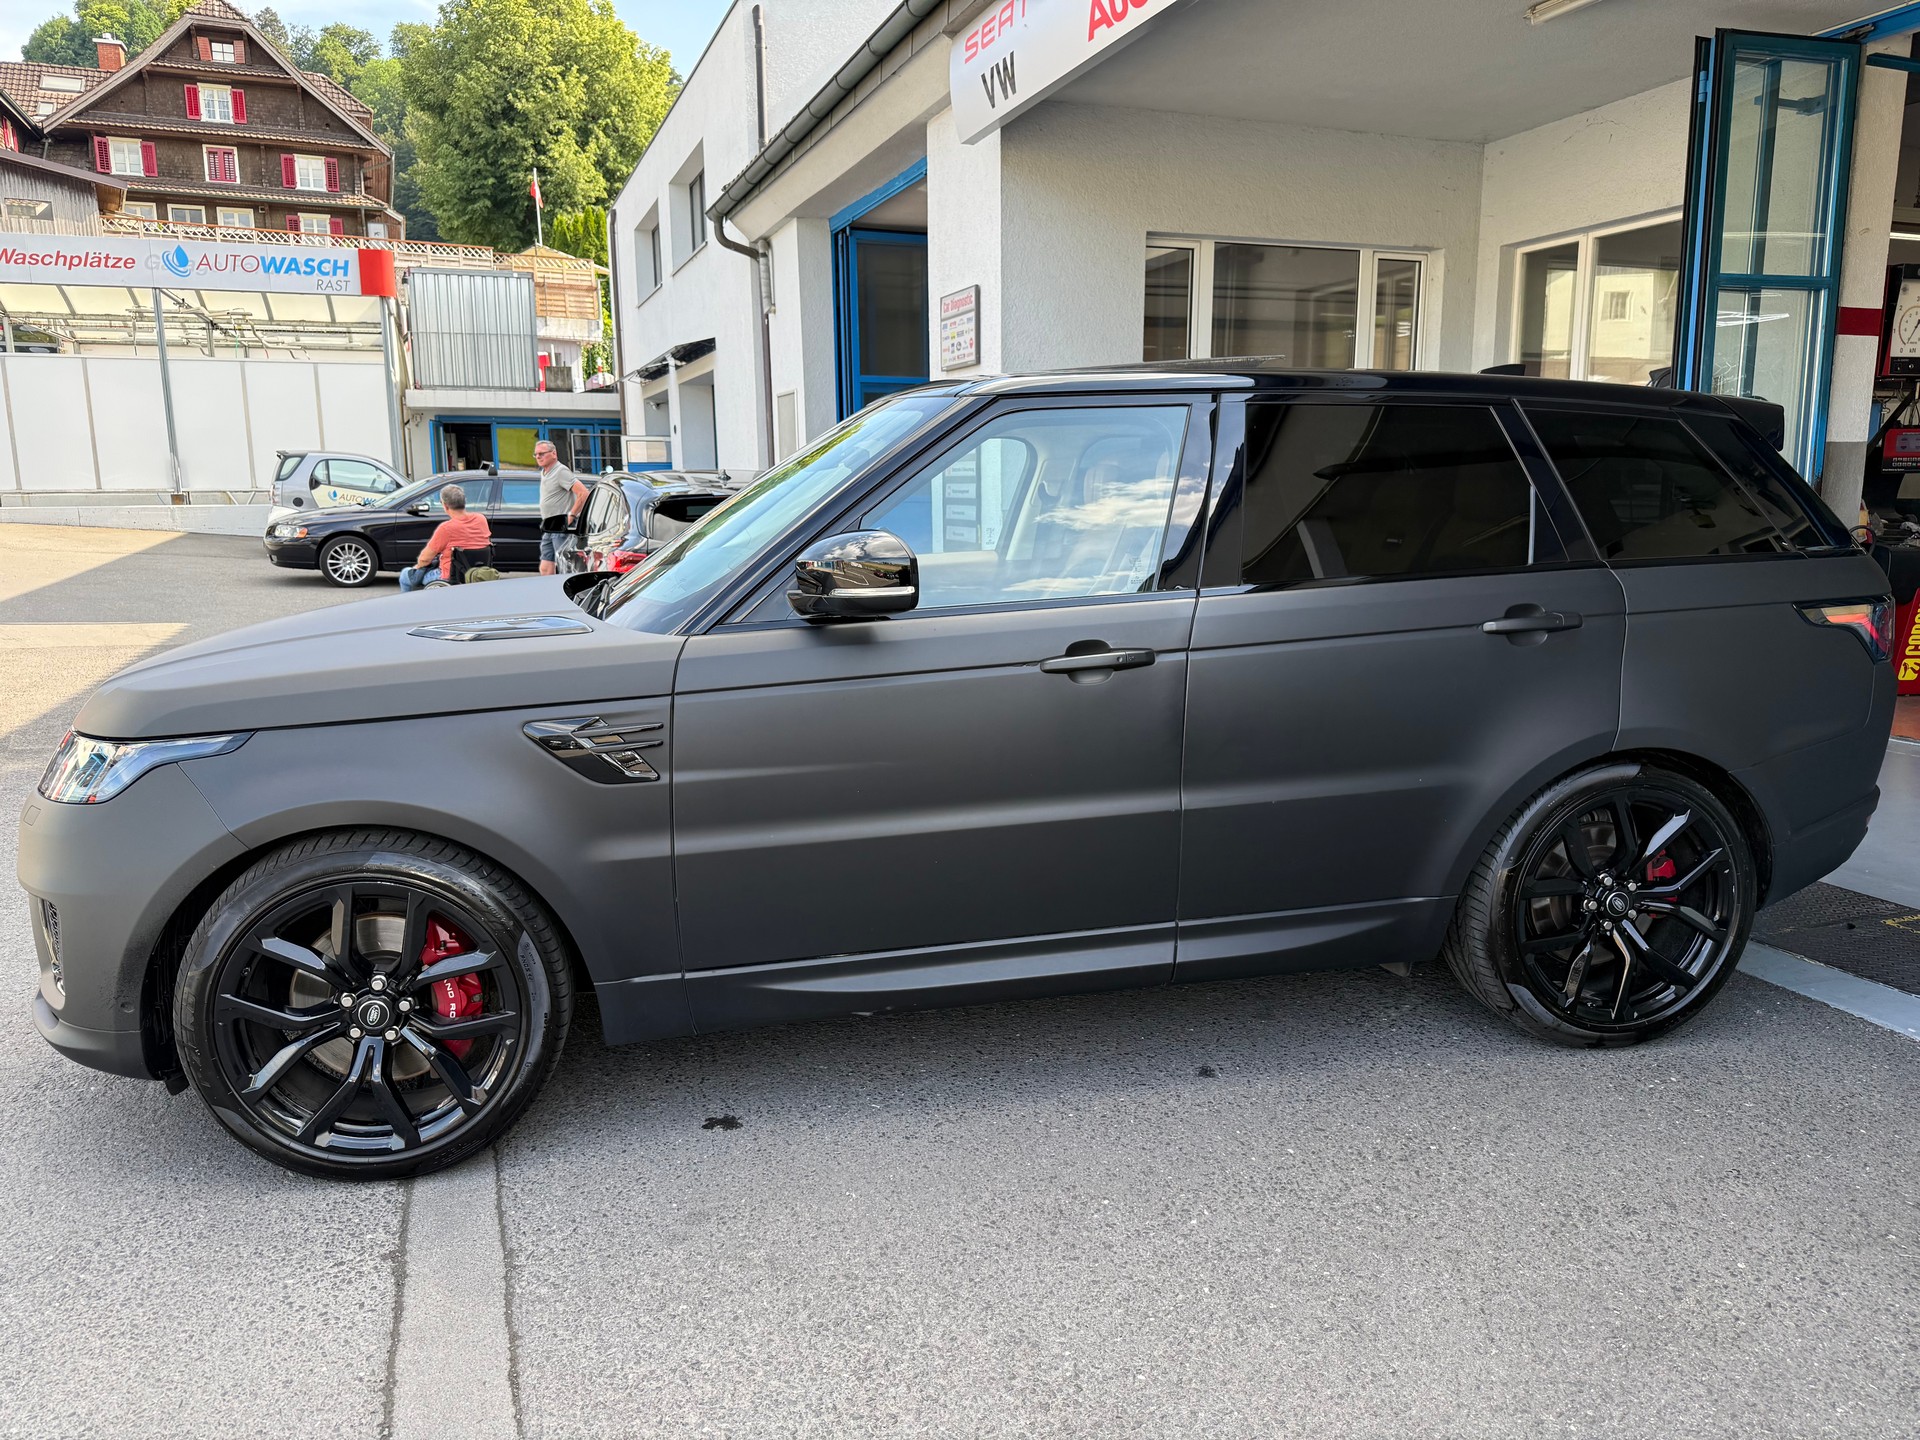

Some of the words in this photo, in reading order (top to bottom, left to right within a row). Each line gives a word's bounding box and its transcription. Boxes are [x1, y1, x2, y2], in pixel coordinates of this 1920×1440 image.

[1088, 0, 1149, 42] AU
[980, 50, 1017, 109] VW
[0, 248, 136, 271] Waschplätze
[196, 253, 350, 277] AUTOWASCH
[316, 279, 351, 292] RAST
